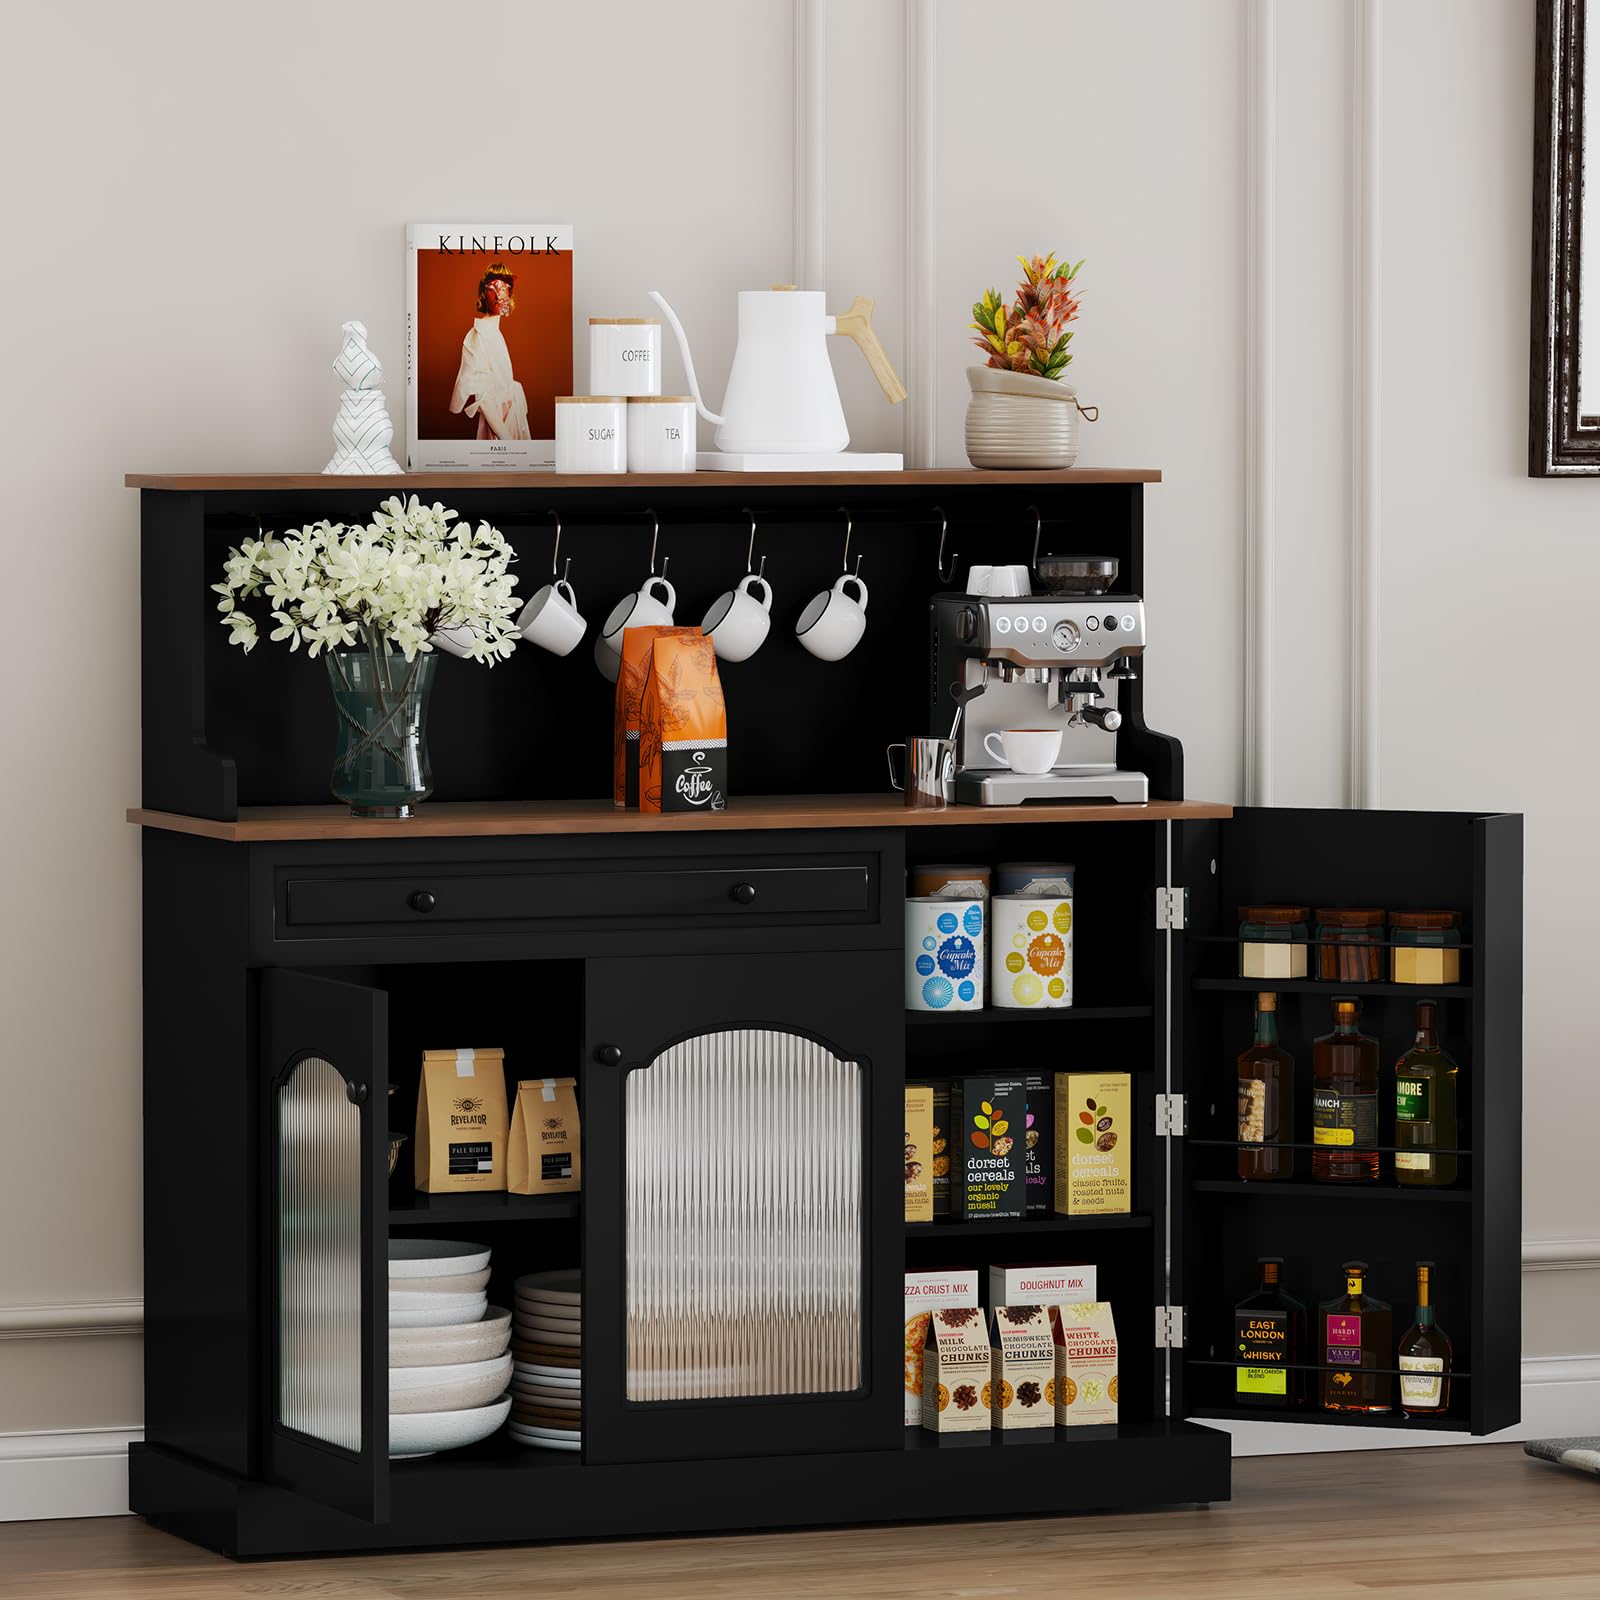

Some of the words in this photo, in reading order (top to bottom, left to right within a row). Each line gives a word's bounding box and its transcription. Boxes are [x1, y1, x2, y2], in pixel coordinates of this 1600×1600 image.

[438, 235, 560, 255] KINFOLK
[622, 350, 651, 362] COFFEE
[665, 428, 681, 440] TEA
[675, 773, 713, 798] Coffee
[451, 1114, 487, 1126] REVELATOR
[967, 1156, 1010, 1169] dorset
[1072, 1151, 1114, 1165] dorset
[967, 1169, 1015, 1182] cereals
[1072, 1165, 1120, 1178] cereals
[967, 1192, 1000, 1202] organic
[1105, 1188, 1125, 1196] nuts
[905, 1286, 921, 1296] ZZA
[922, 1284, 950, 1295] CRUST
[952, 1283, 969, 1293] MIX
[1020, 1279, 1065, 1291] DOUGHNUT
[1067, 1278, 1083, 1289] MIX
[1249, 1320, 1276, 1330] EAST
[1002, 1335, 1051, 1343] SEMISWEET
[1066, 1331, 1100, 1339] WHITE
[1240, 1329, 1285, 1340] LONDON
[939, 1337, 965, 1345] MILK
[1004, 1342, 1052, 1350] CHOCOLATE
[1067, 1338, 1116, 1347] CHOCOLATE
[940, 1345, 989, 1353] CHOCOLATE
[1005, 1349, 1053, 1359] CHUNKS
[1068, 1346, 1116, 1356] CHUNKS
[941, 1352, 989, 1362] CHUNKS
[1243, 1351, 1282, 1360] WHISKY
